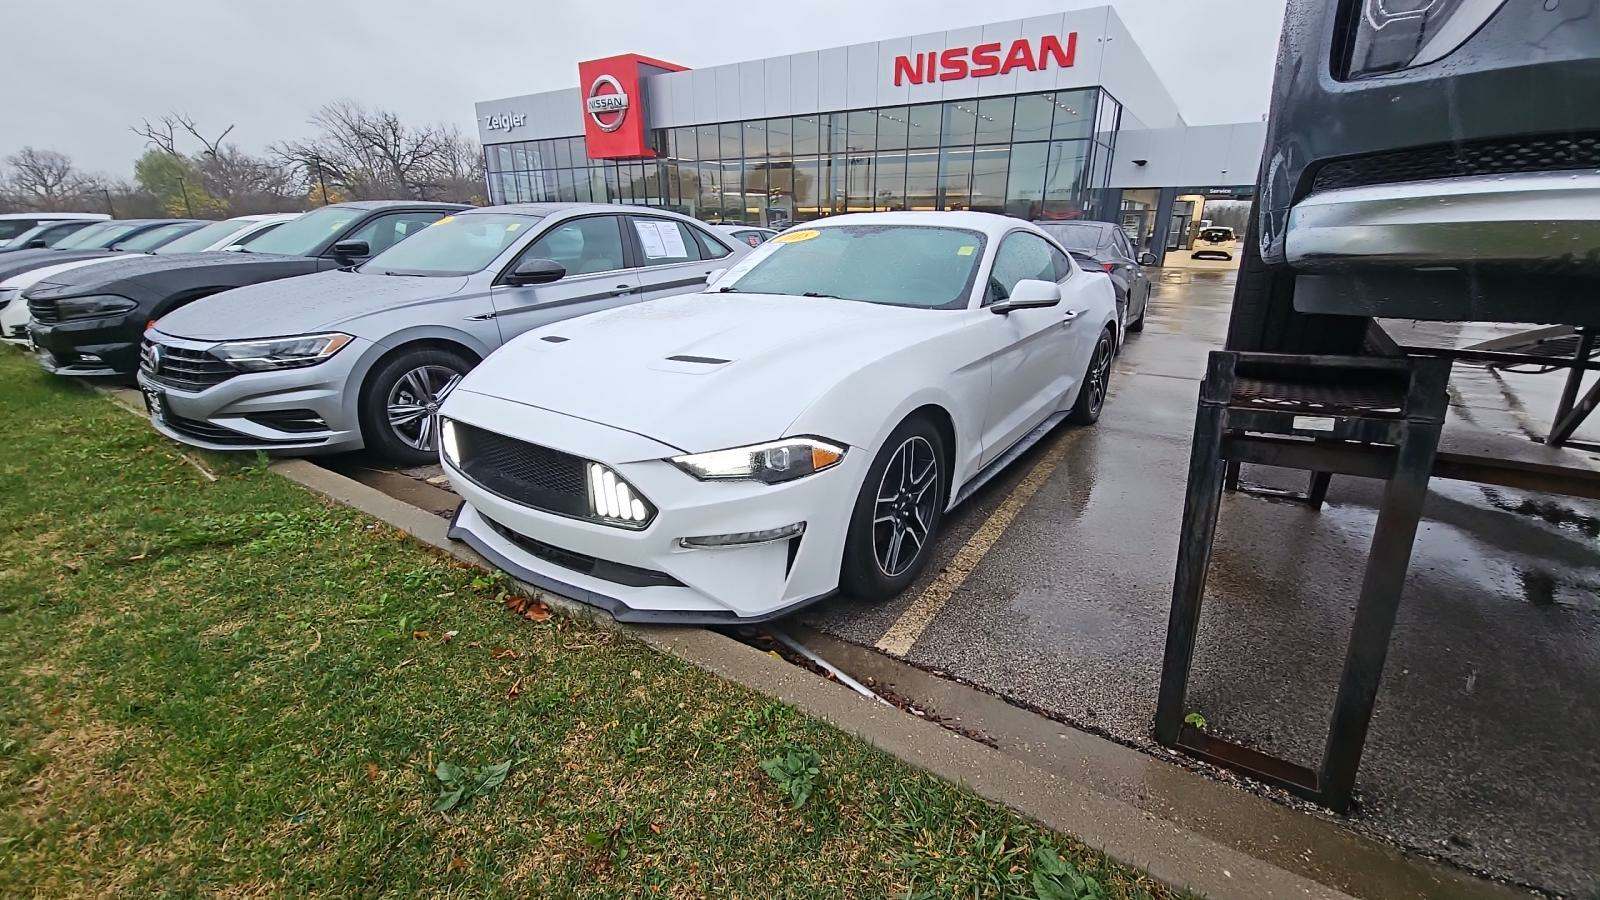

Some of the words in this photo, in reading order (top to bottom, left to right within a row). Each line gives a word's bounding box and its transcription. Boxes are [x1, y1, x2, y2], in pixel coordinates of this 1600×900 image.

[894, 32, 1078, 86] NISSAN
[589, 97, 623, 109] NISSAN
[485, 111, 527, 132] Zeigler
